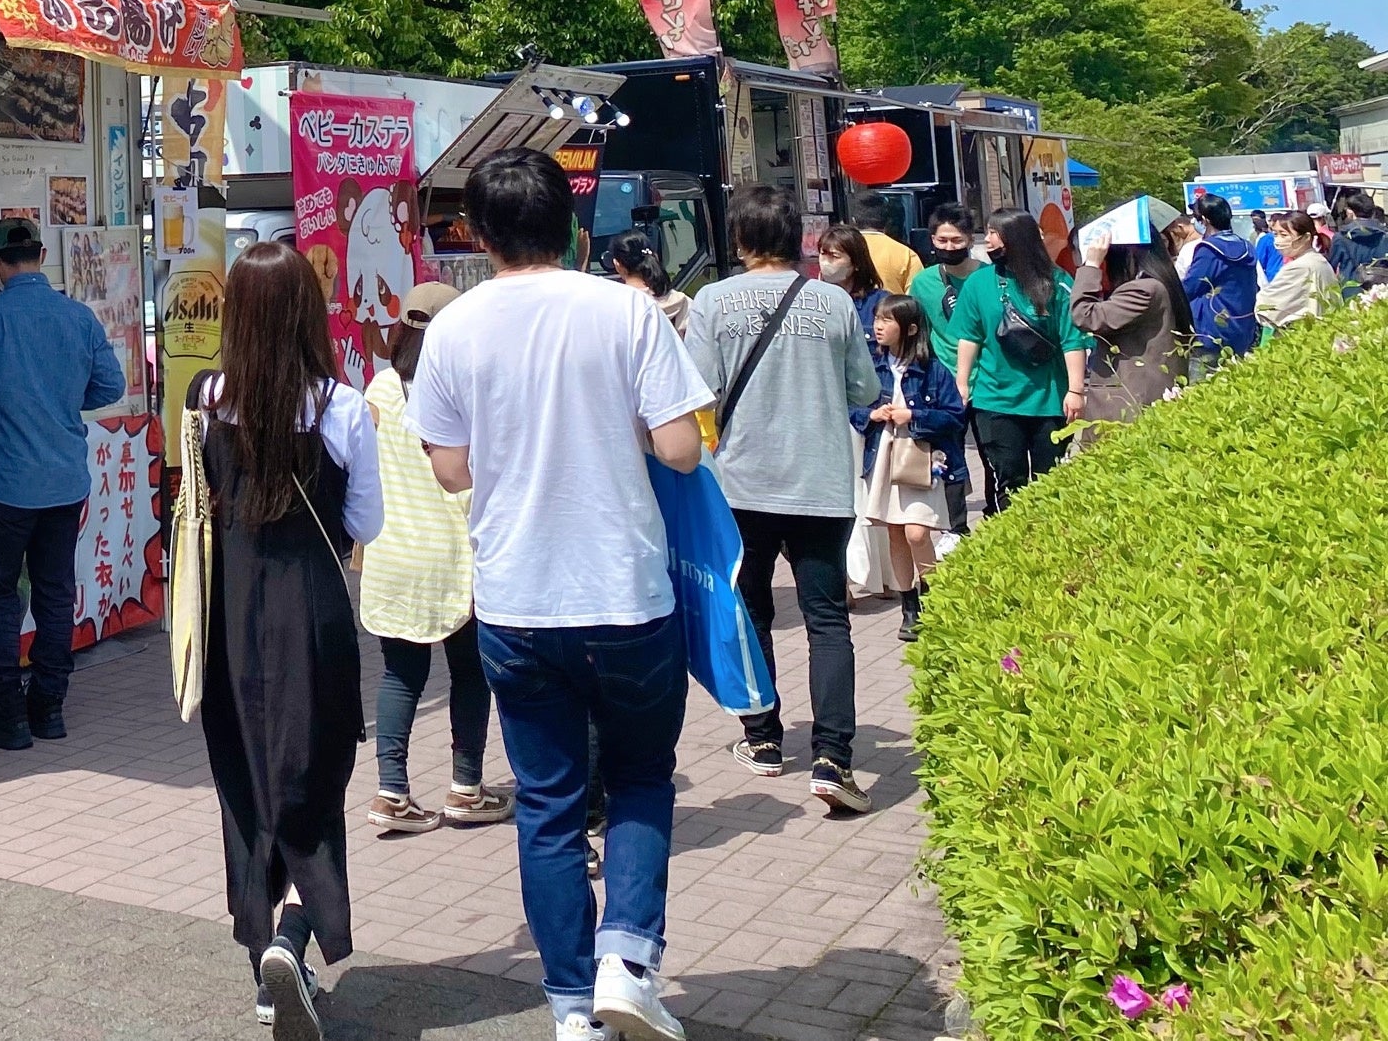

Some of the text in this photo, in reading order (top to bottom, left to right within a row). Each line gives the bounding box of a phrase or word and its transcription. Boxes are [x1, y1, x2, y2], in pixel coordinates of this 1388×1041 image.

[299, 110, 412, 149] ベビーカステラ
[316, 151, 403, 176] パンダにきゅんです
[300, 207, 337, 239] おいしい
[164, 293, 219, 322] Asahi
[184, 322, 195, 333] 生
[747, 315, 826, 340] BNES
